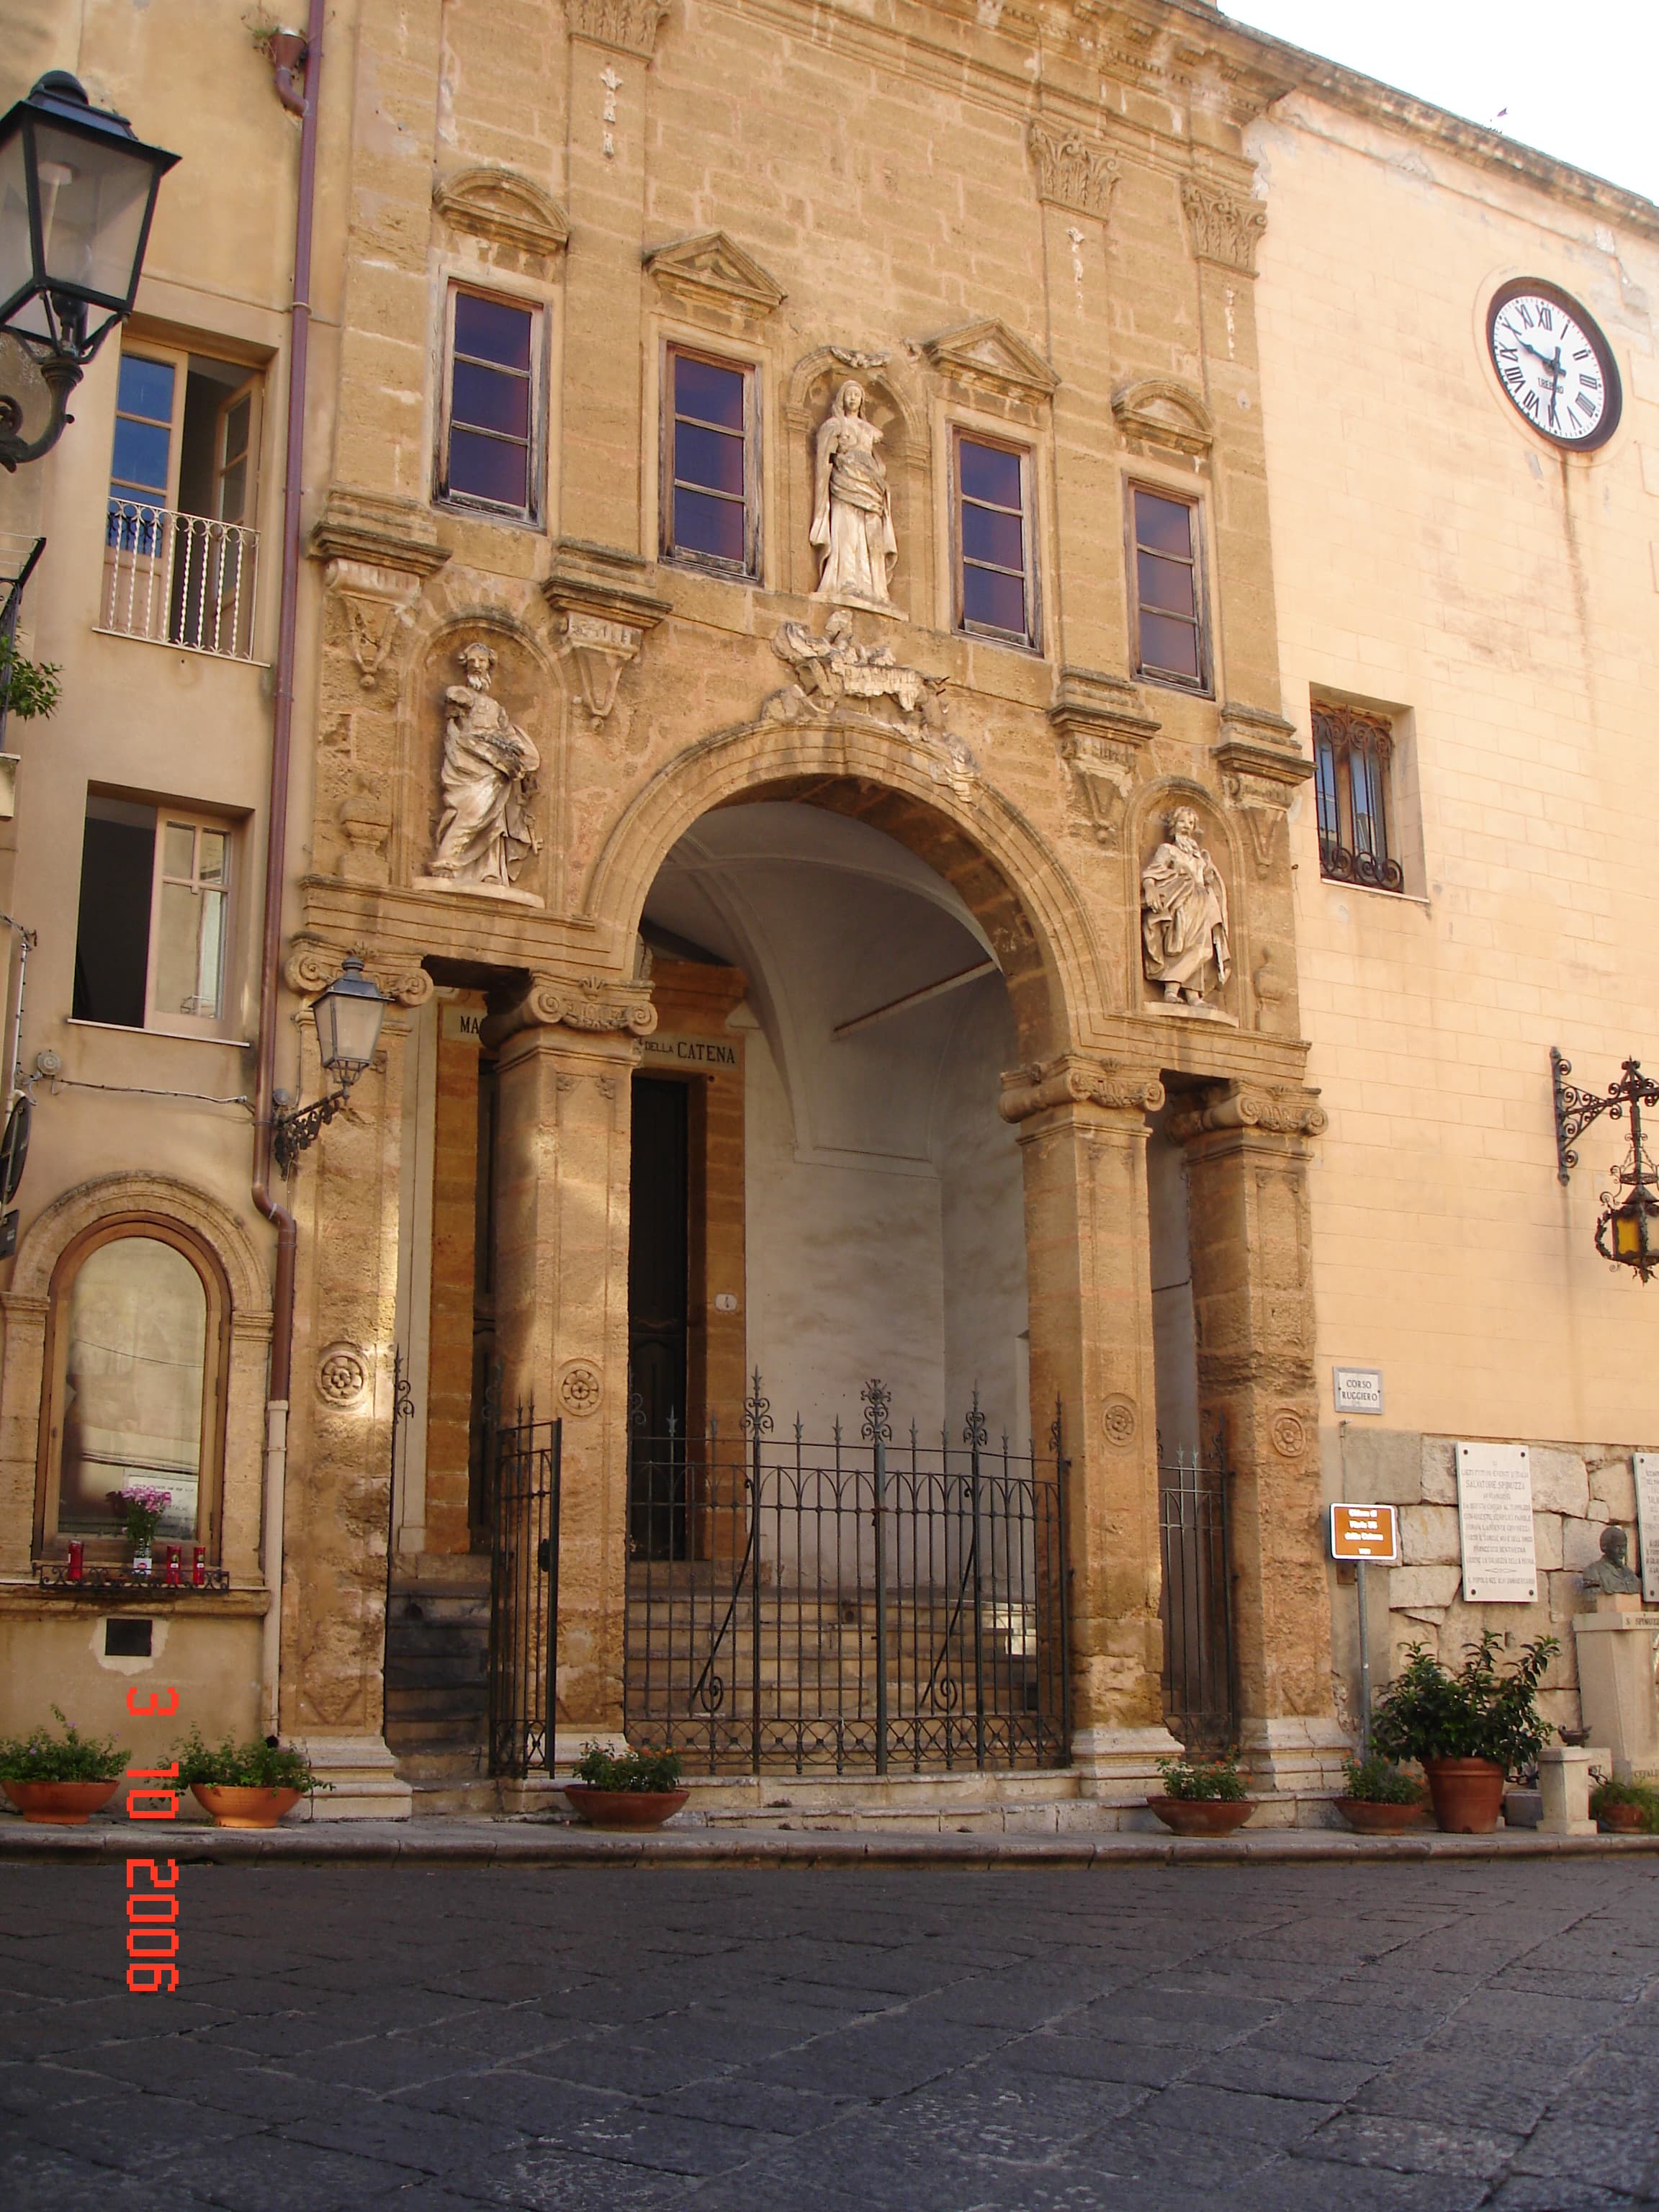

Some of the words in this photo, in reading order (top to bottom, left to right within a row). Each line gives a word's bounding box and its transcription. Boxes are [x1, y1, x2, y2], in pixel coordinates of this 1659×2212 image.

[678, 1041, 735, 1064] CATENA
[1346, 1380, 1371, 1388] CORSO
[1341, 1391, 1377, 1401] RUGGIERO
